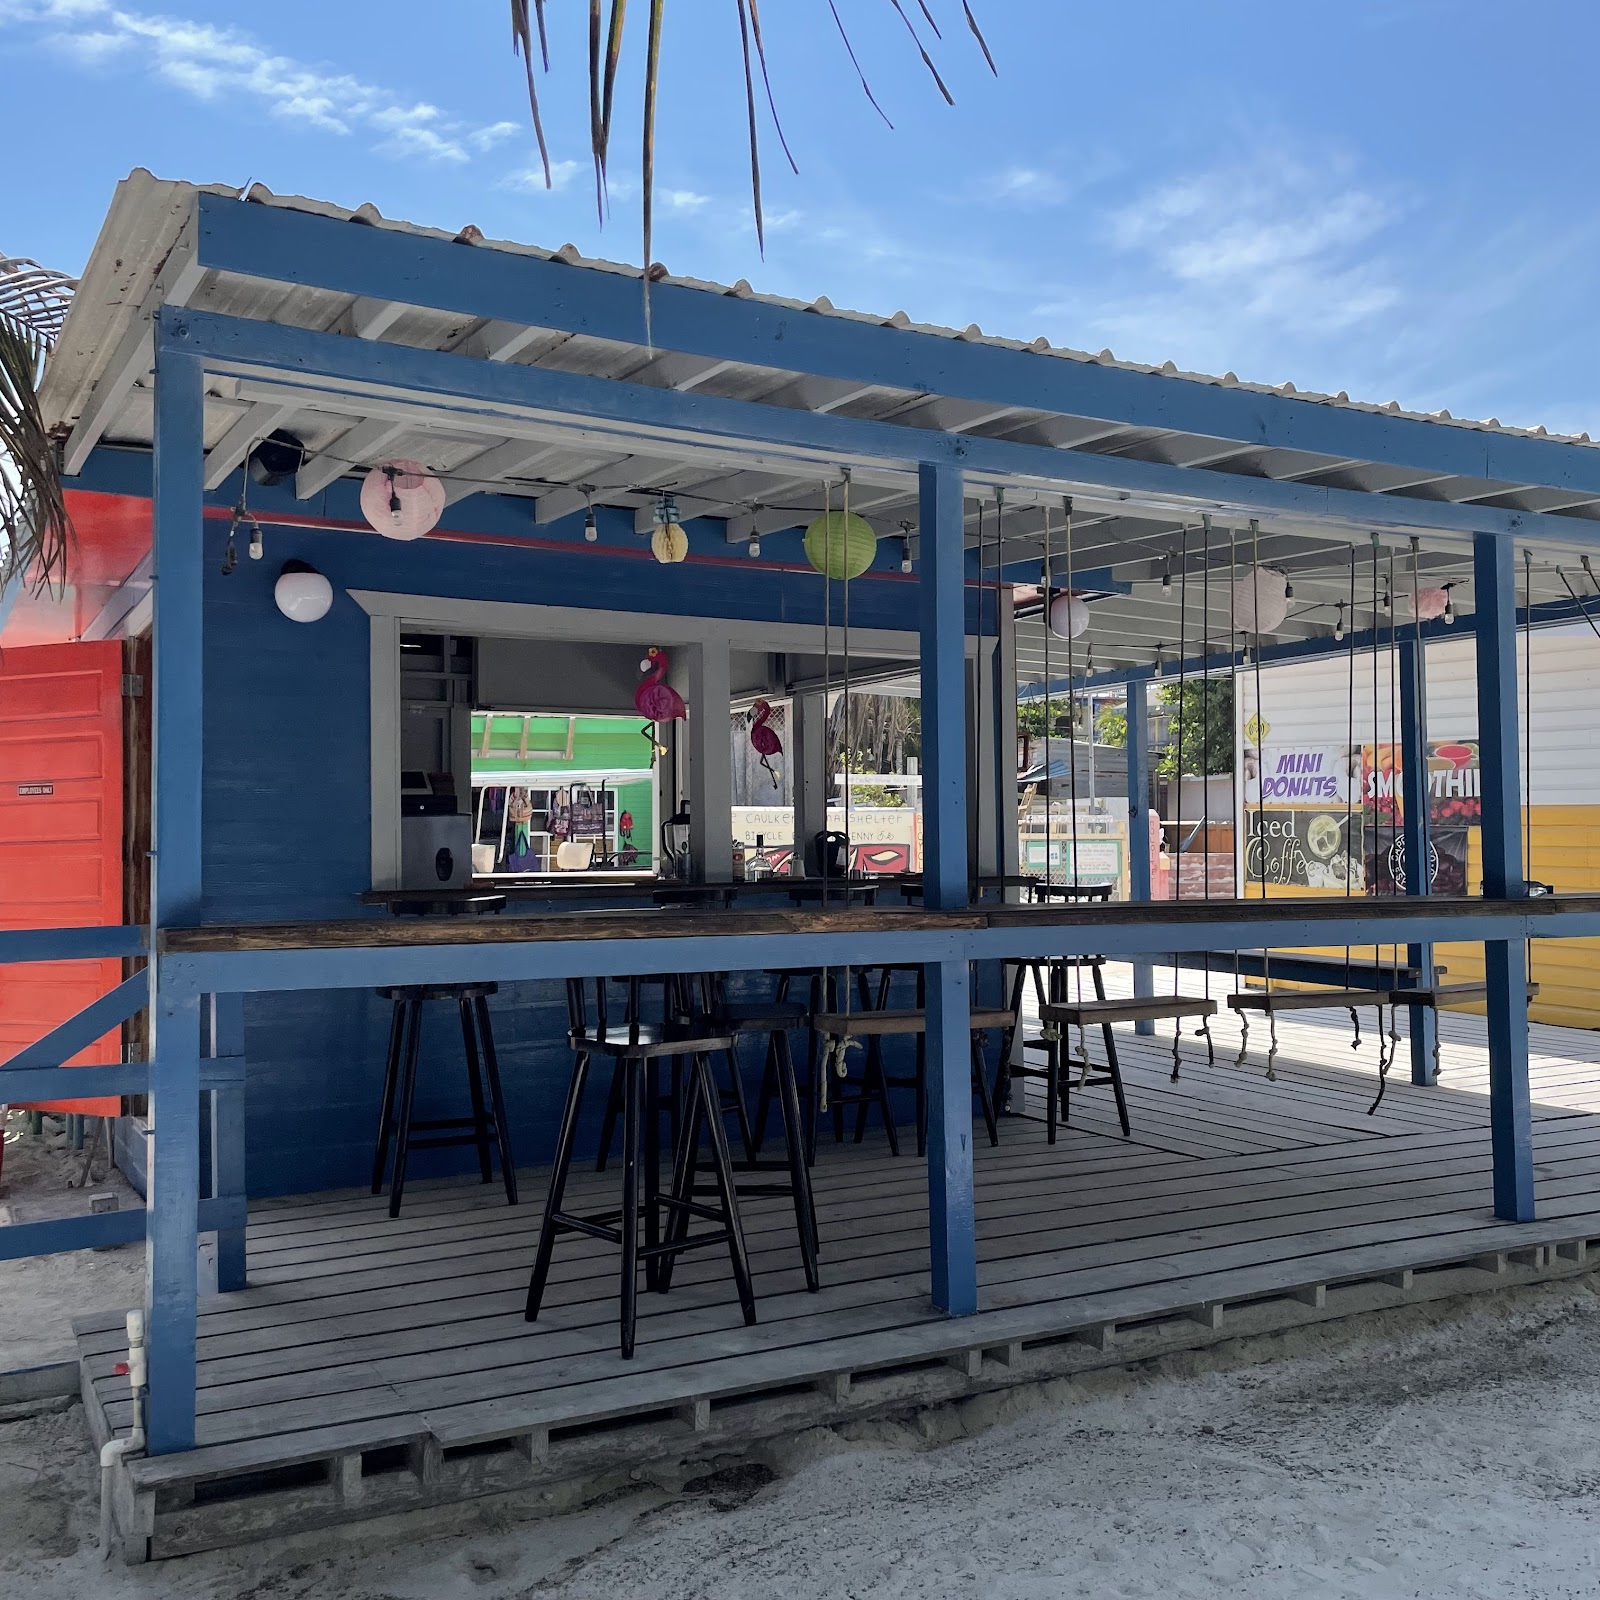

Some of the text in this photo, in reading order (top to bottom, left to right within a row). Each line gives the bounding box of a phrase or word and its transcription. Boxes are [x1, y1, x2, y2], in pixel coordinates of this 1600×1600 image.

[1276, 753, 1323, 774] MINI
[1261, 776, 1338, 799] DONUTS
[1367, 768, 1481, 799] SMTHI
[1247, 810, 1298, 838] Iced
[848, 831, 874, 841] ENNY
